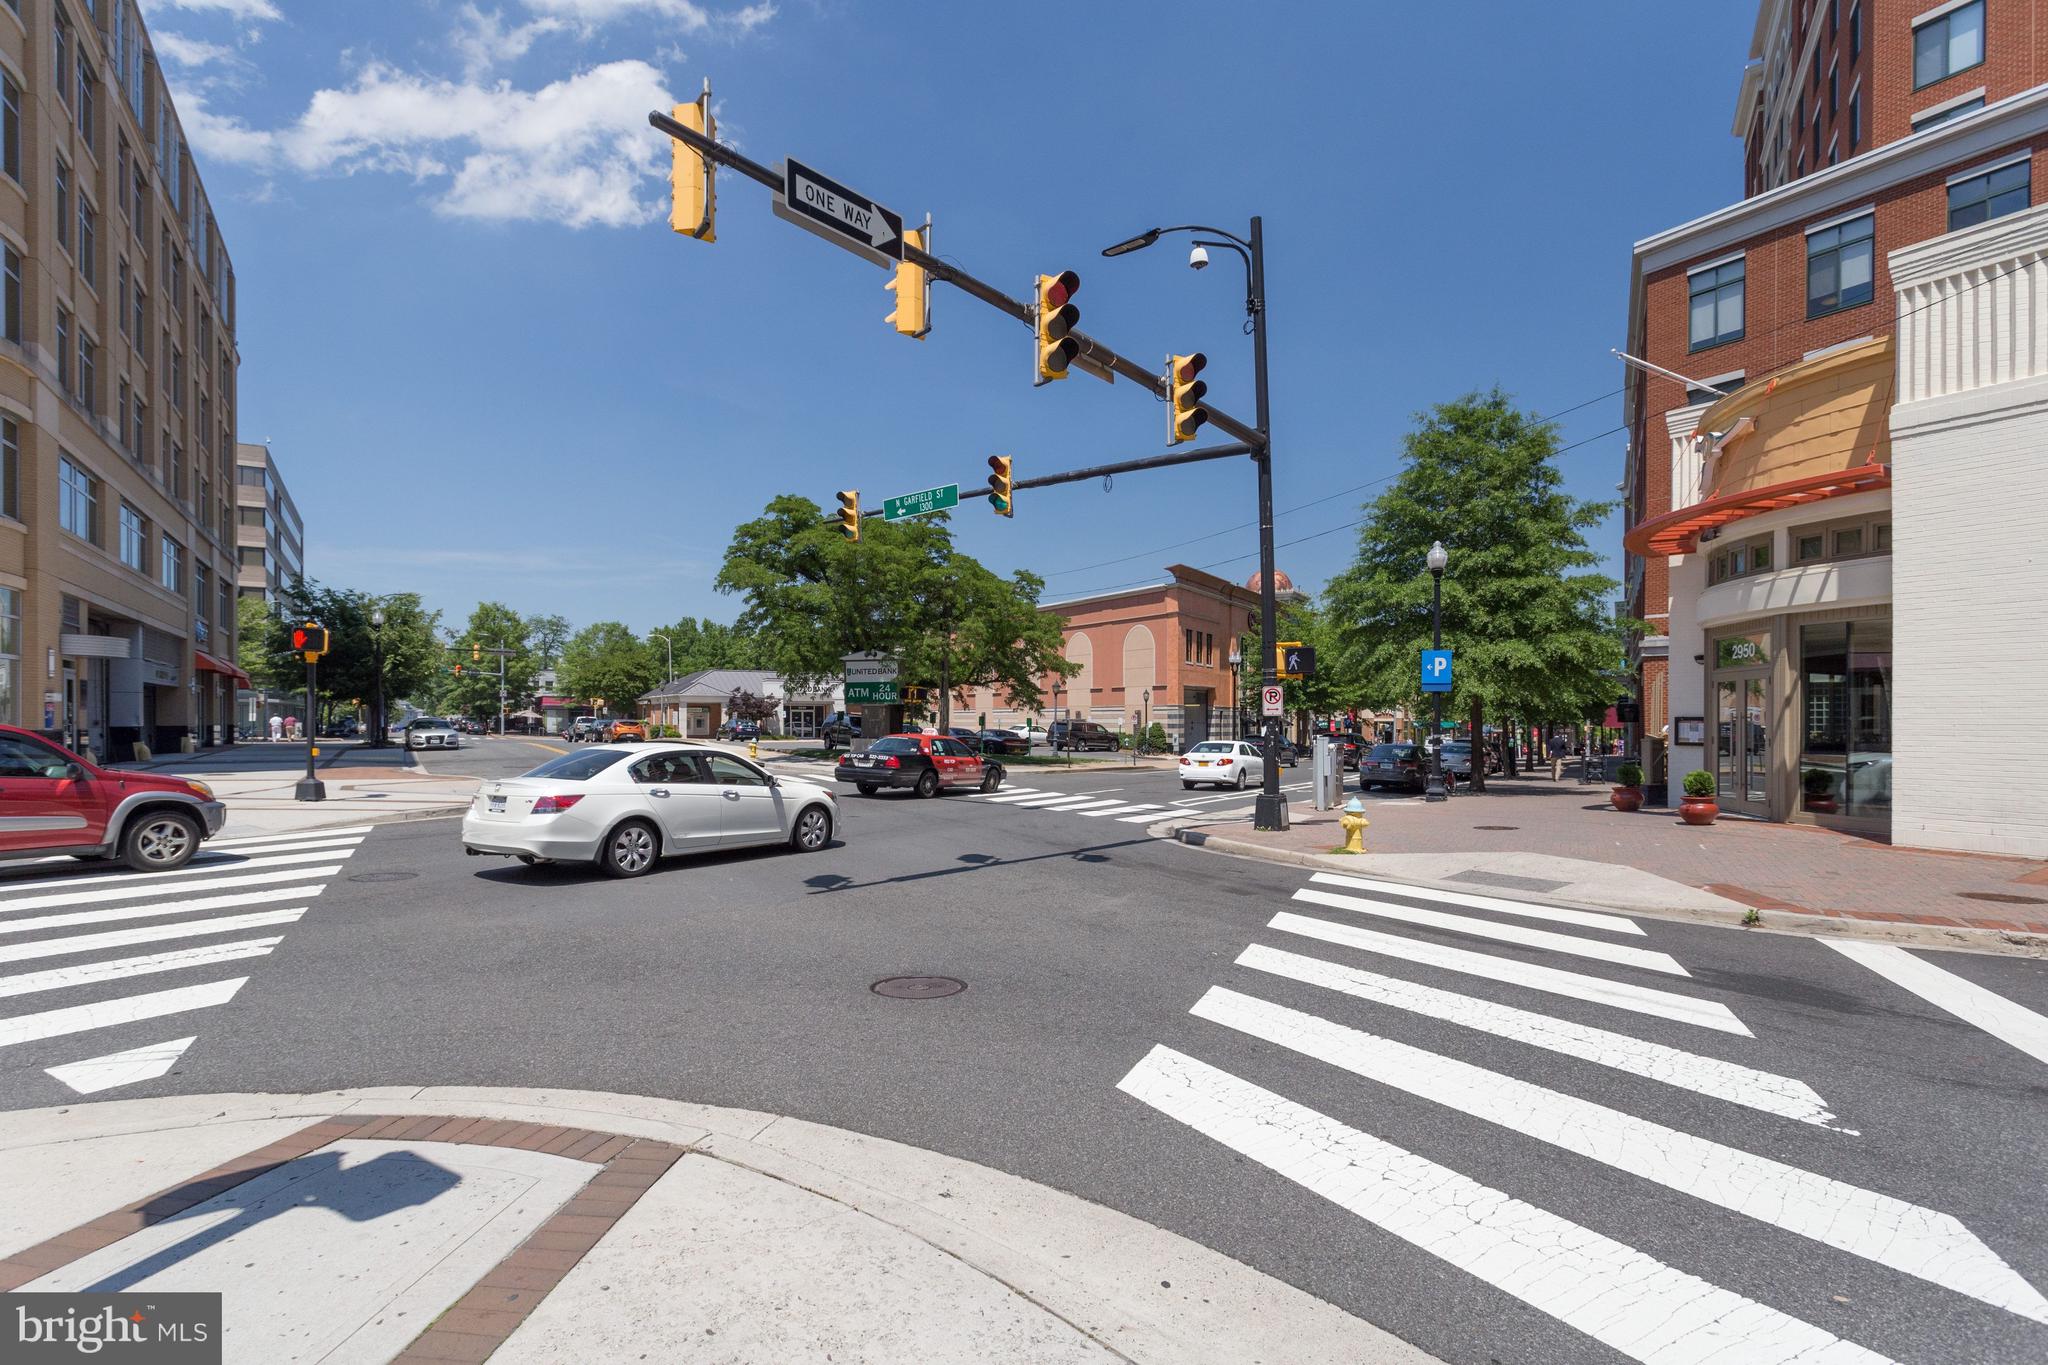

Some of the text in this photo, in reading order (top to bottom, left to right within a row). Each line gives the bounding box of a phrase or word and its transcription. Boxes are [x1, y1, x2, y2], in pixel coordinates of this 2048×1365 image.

[805, 184, 871, 230] ONE WAY
[895, 489, 944, 507] N GARFIELD ST
[919, 501, 933, 512] 1300
[1732, 642, 1755, 659] 2950
[878, 667, 897, 675] BANK
[1434, 657, 1447, 677] P
[847, 688, 897, 700] ATM HOUR
[879, 684, 891, 692] 24
[1269, 691, 1278, 702] P
